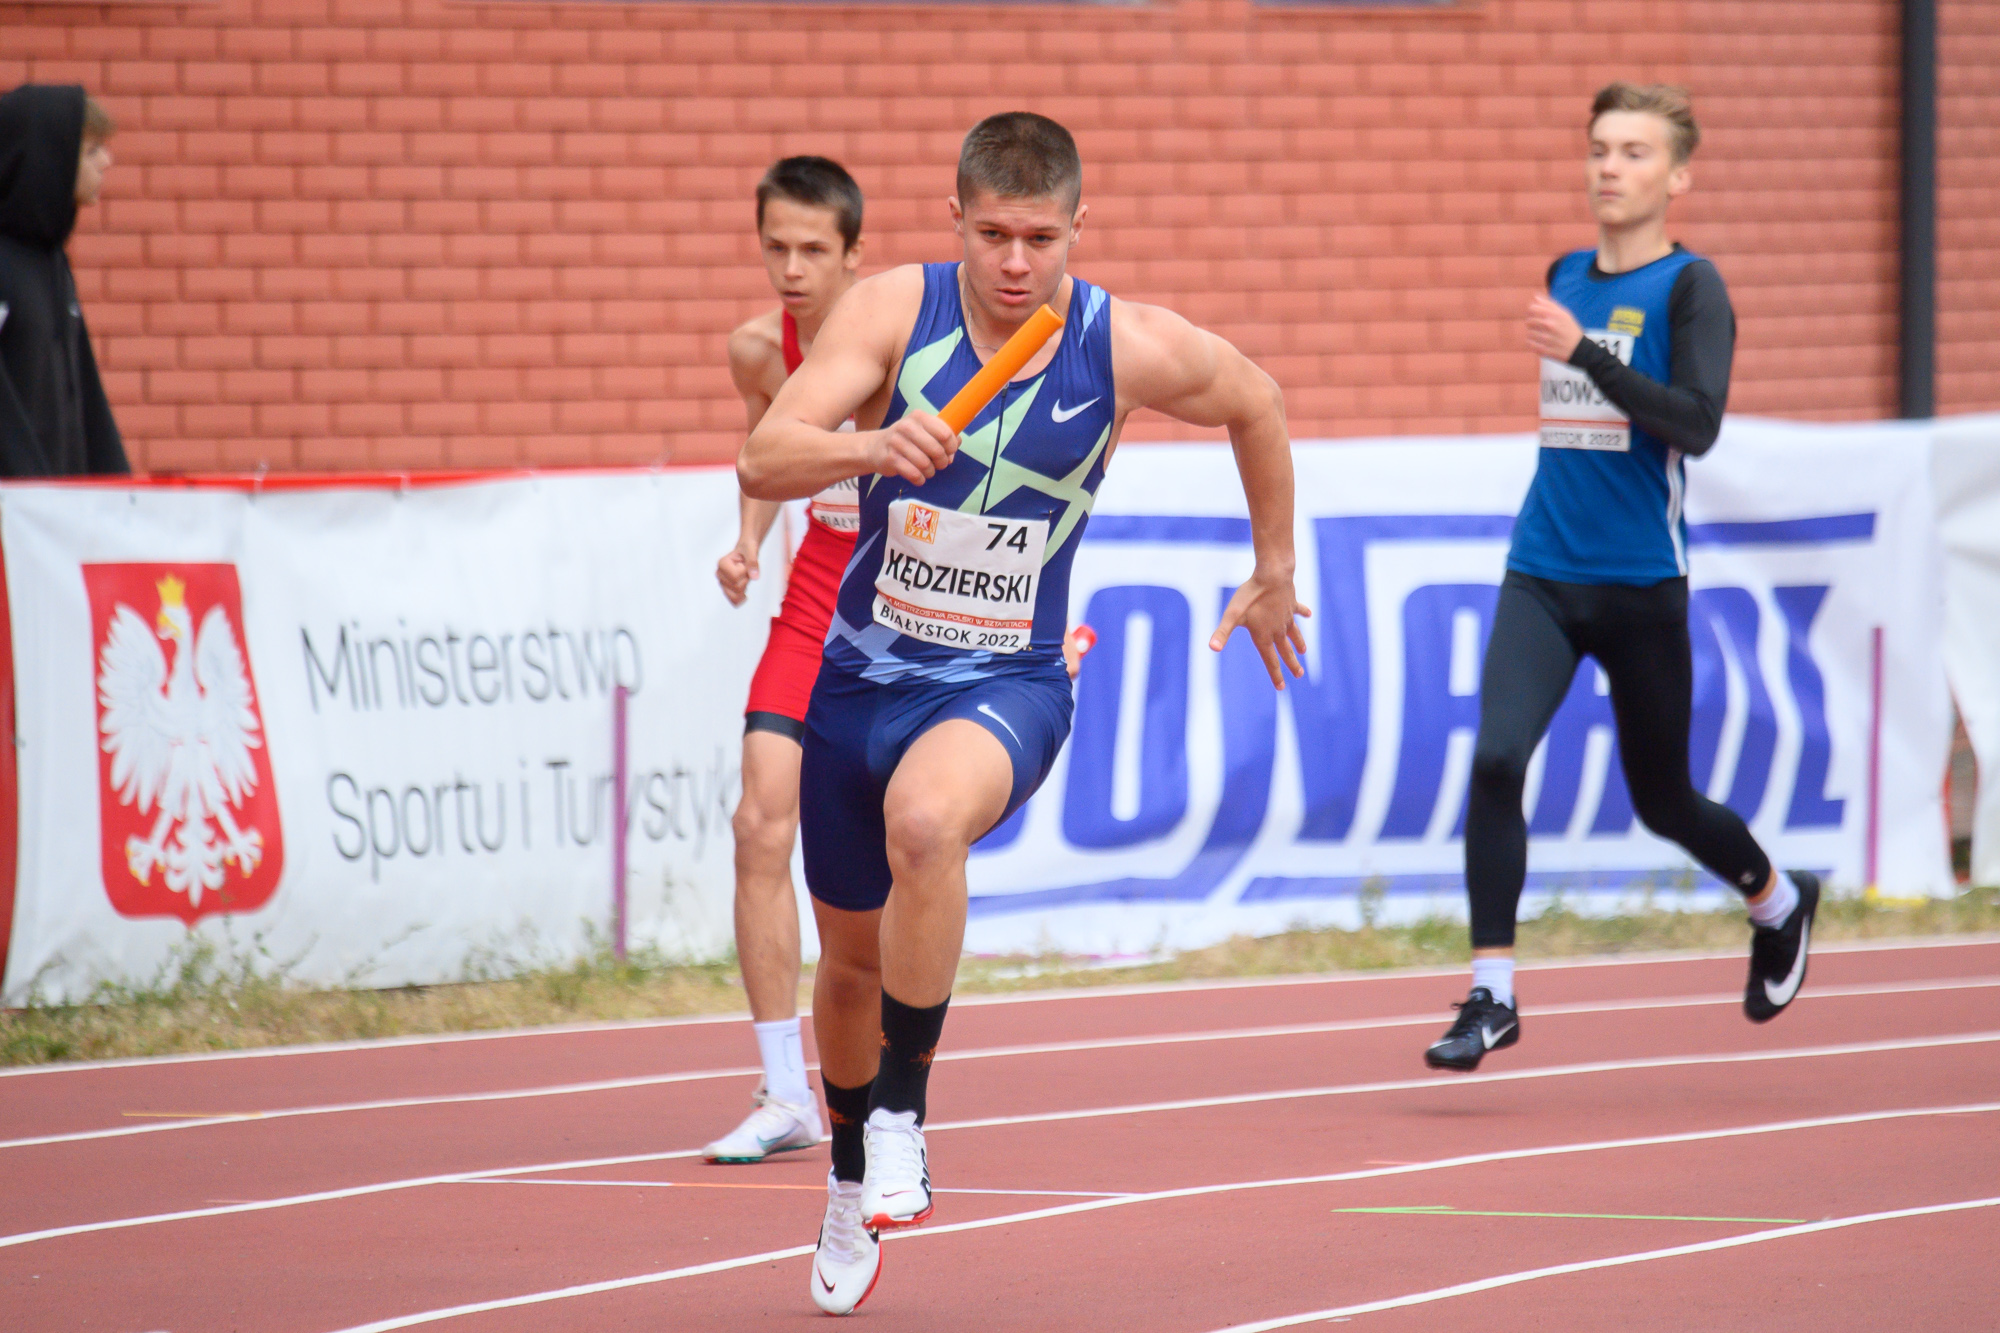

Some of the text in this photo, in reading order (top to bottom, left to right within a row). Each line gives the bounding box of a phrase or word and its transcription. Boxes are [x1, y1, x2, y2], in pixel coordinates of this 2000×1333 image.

[1587, 433, 1622, 446] 2022
[820, 515, 860, 529] BIAŁY
[985, 523, 1028, 554] 74
[885, 548, 1032, 603] KĘDZIERSKI
[880, 604, 1020, 648] BIAŁYSTOK 2022
[947, 613, 974, 624] POLSKI
[975, 618, 984, 626] W
[299, 617, 644, 713] Ministerstwo
[327, 744, 741, 883] Sportu i Turystyk
